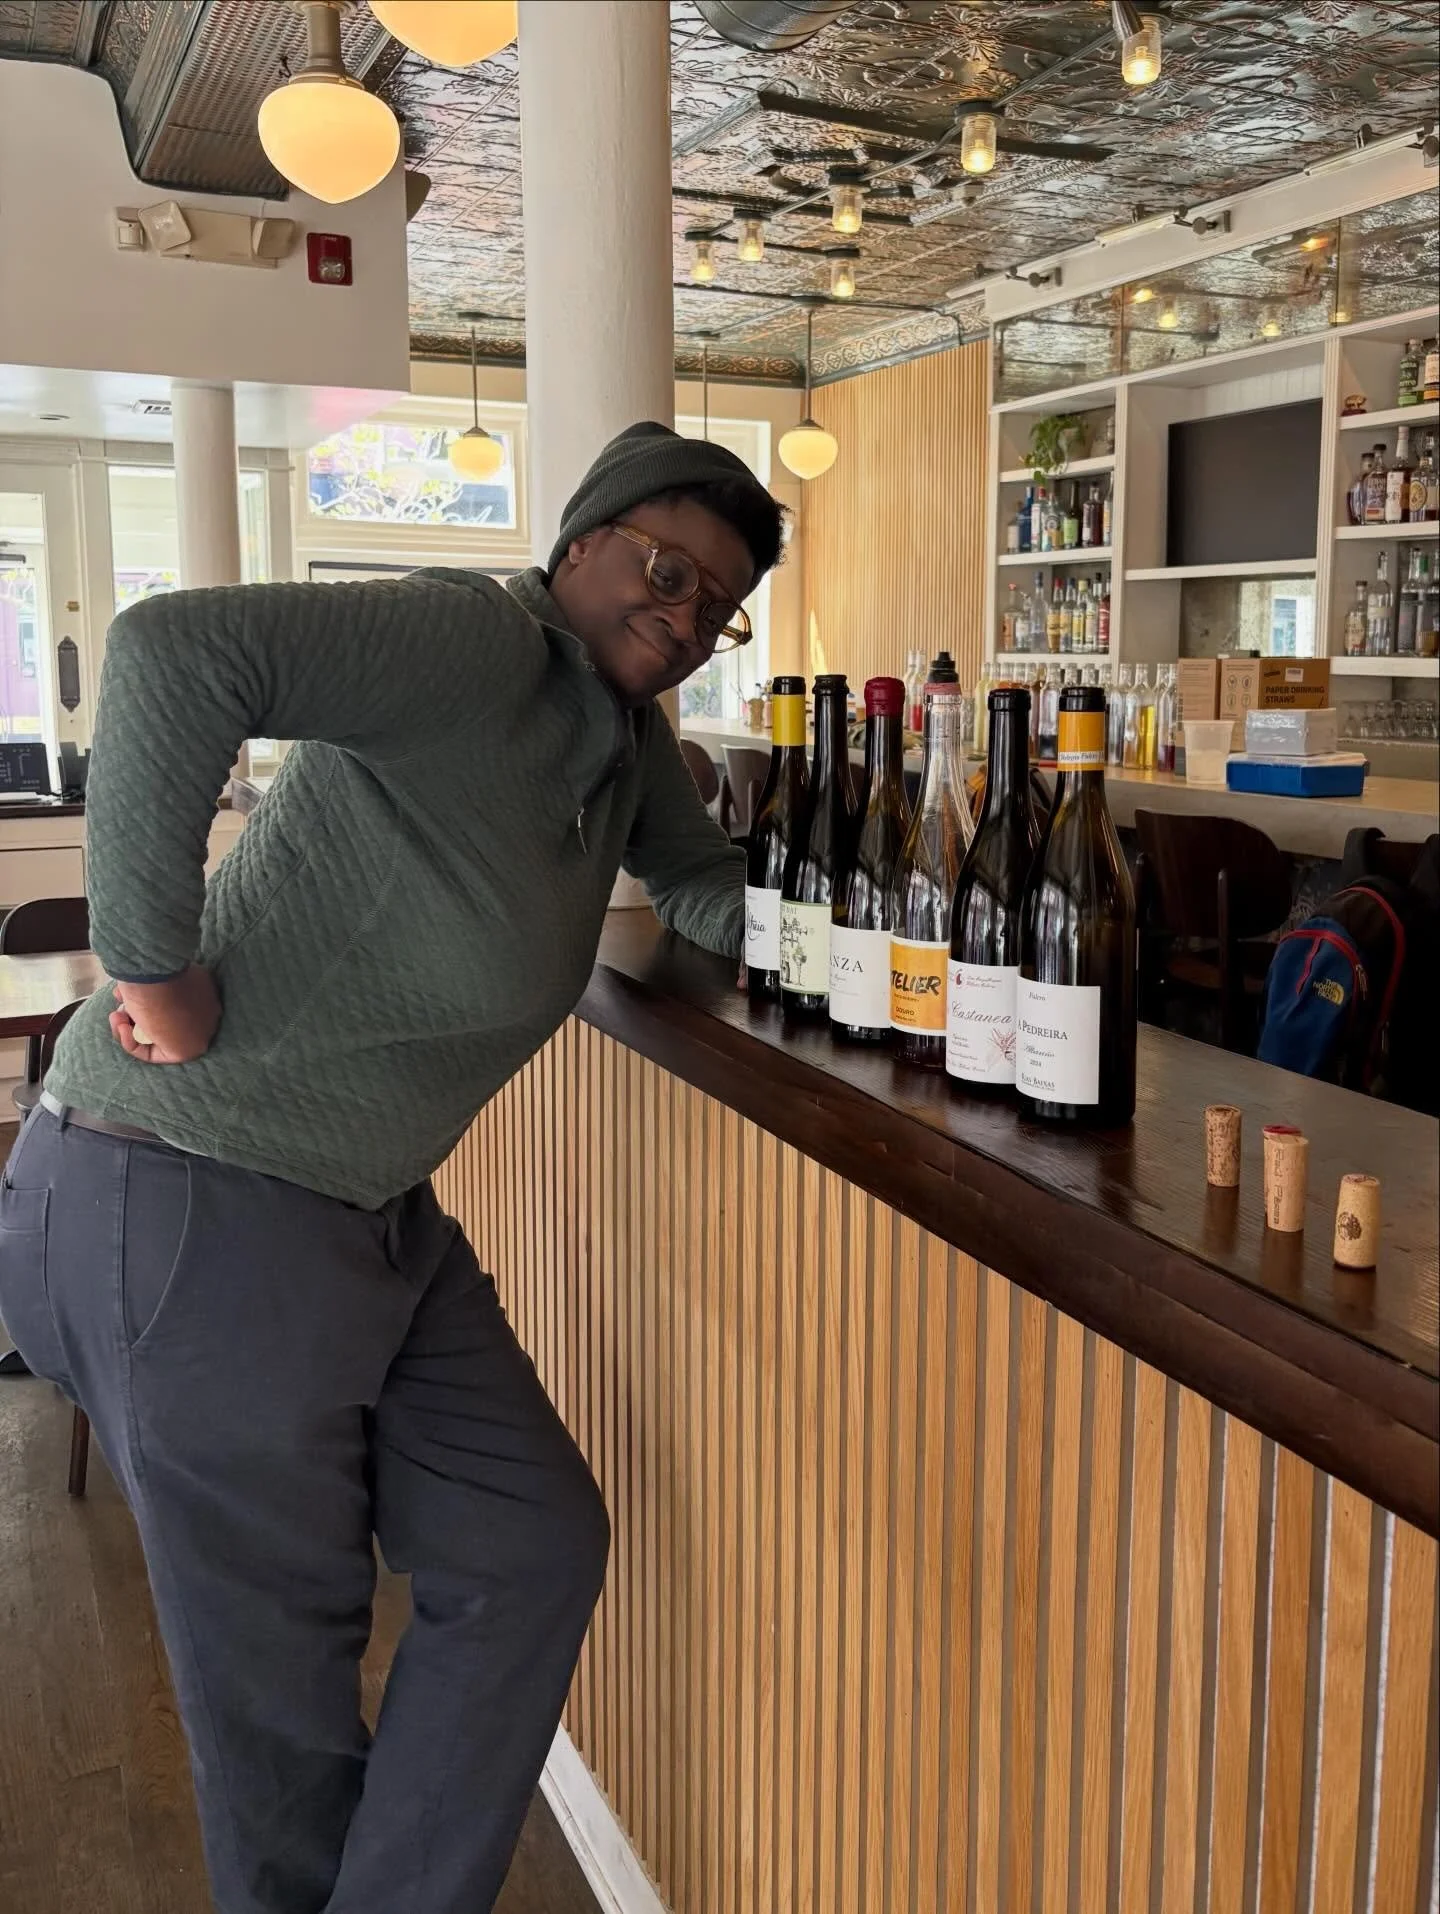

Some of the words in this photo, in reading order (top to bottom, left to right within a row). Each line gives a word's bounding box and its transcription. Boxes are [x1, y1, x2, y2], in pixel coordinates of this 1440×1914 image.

[1264, 686, 1289, 694] PAPER
[1291, 686, 1325, 694] DRINKING
[1264, 695, 1295, 704] STRAWS
[952, 1000, 1012, 1024] Castanea
[1022, 1019, 1068, 1041] PEDREIRA
